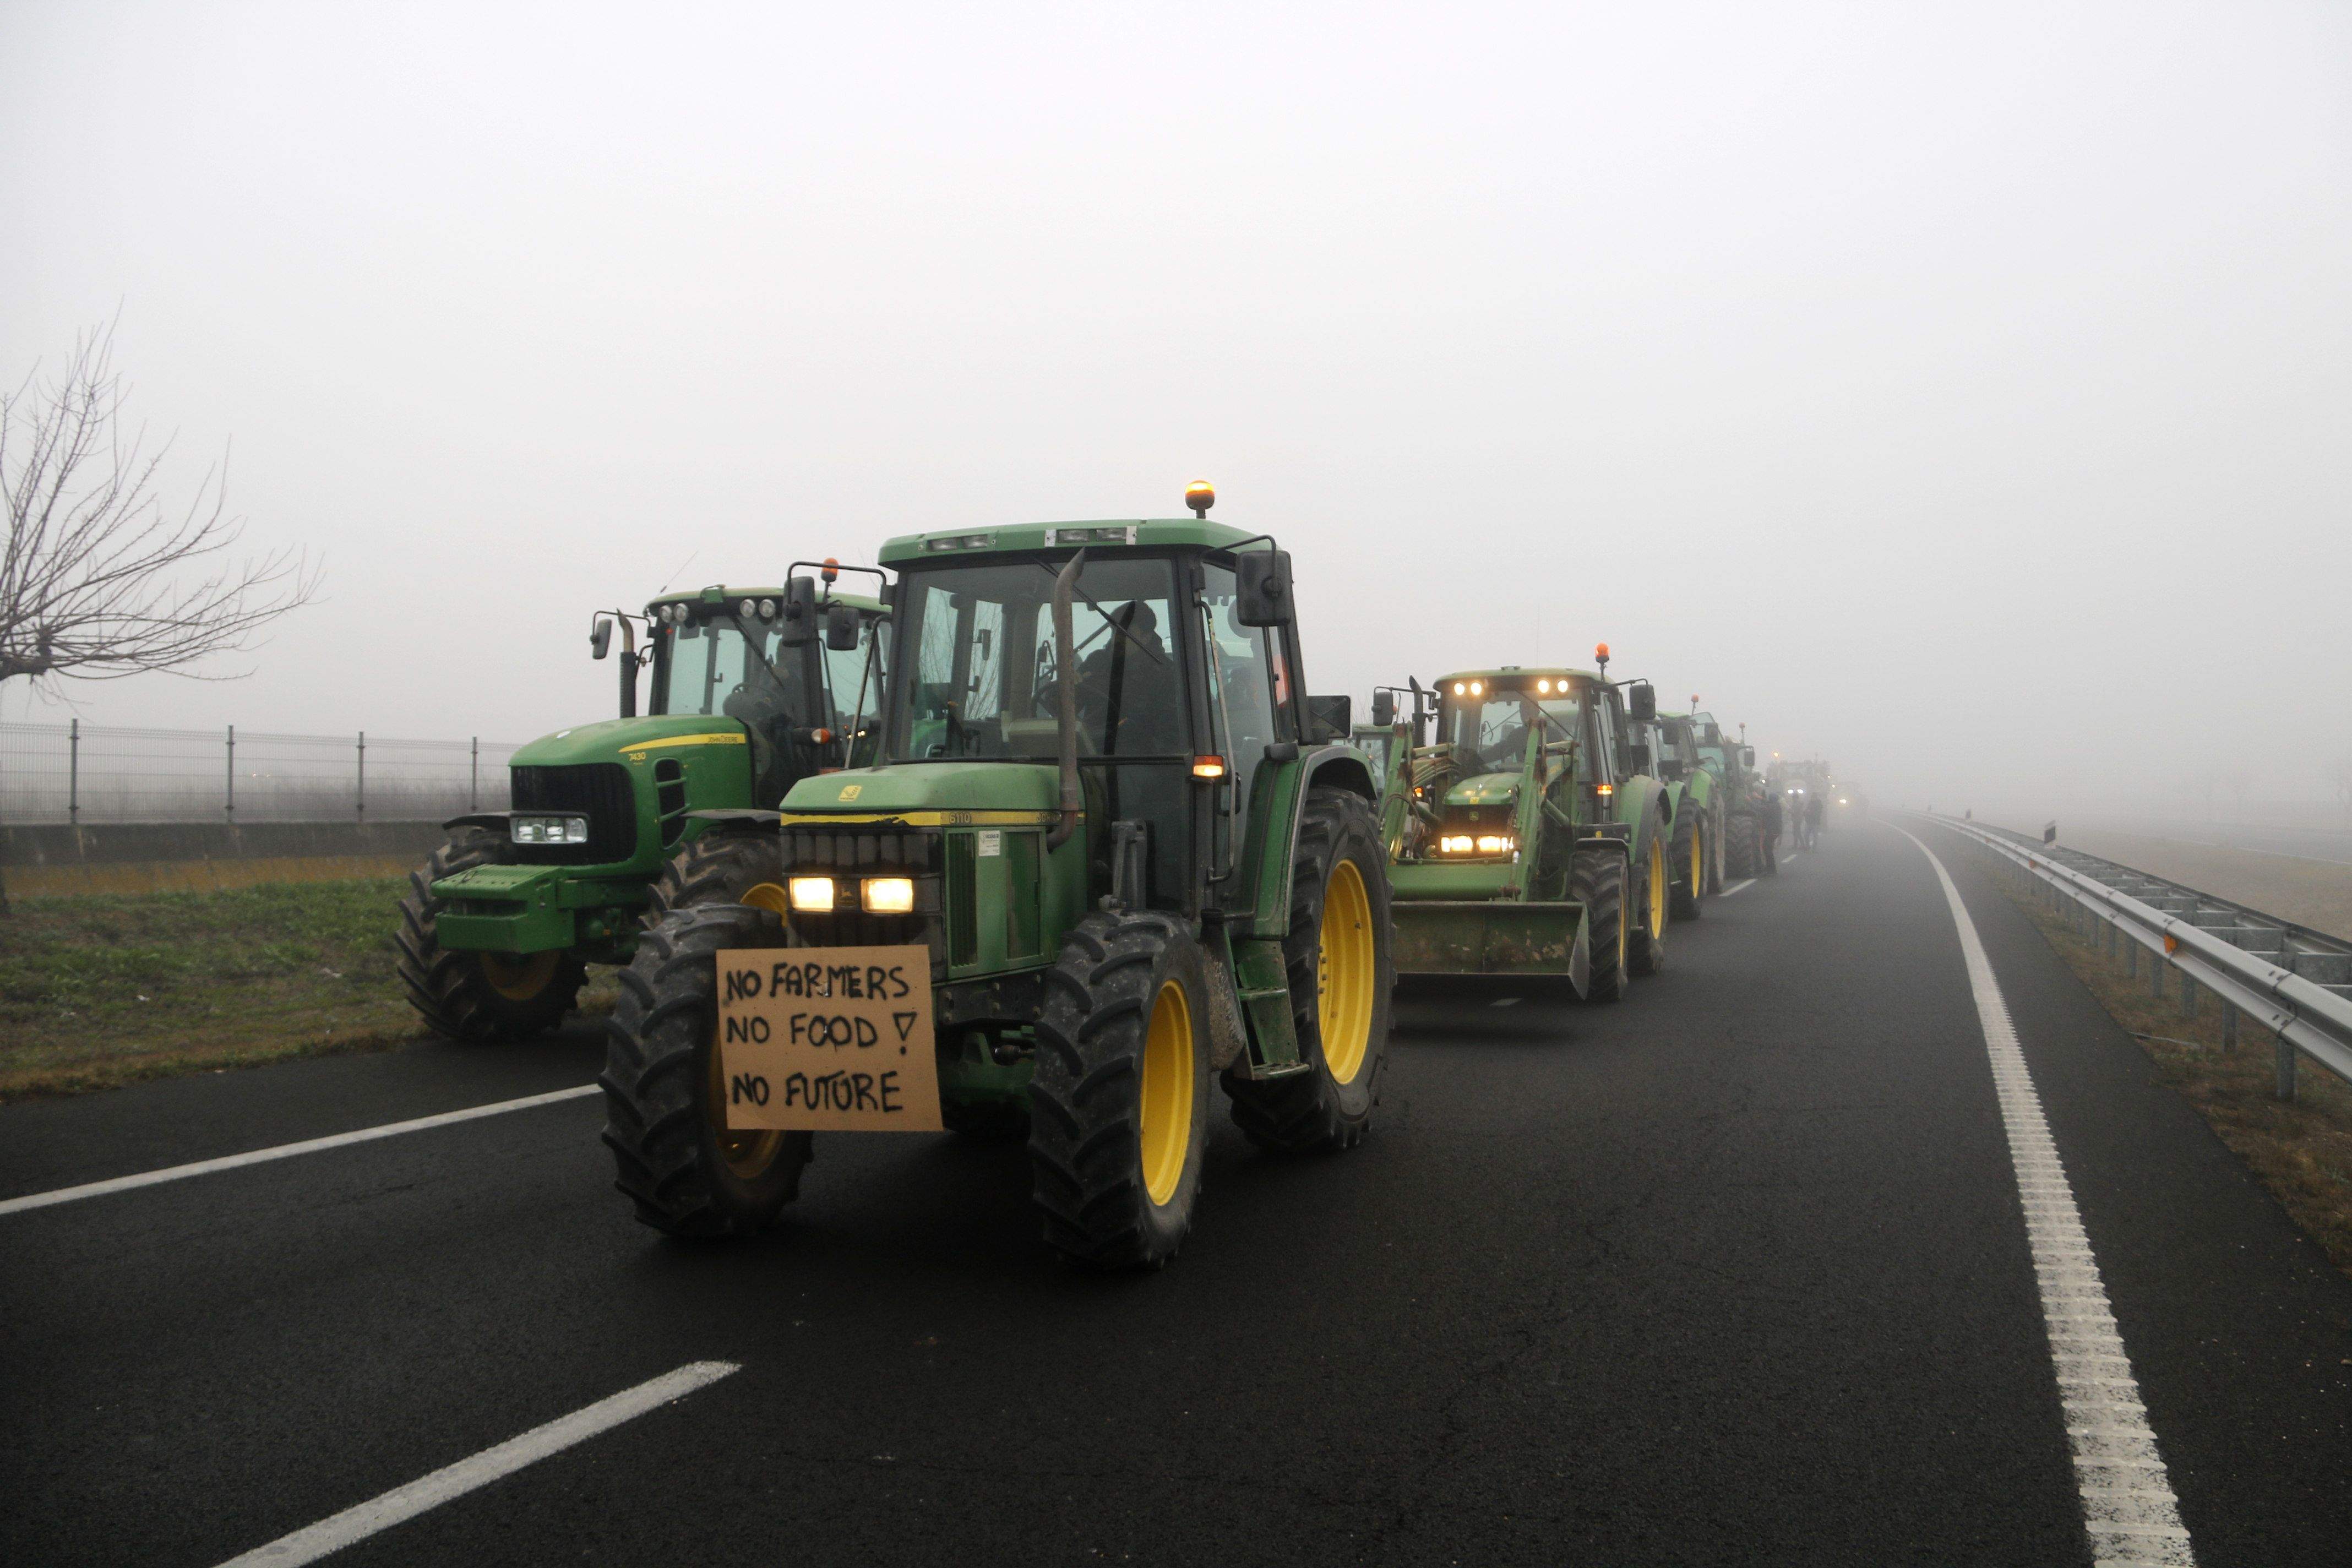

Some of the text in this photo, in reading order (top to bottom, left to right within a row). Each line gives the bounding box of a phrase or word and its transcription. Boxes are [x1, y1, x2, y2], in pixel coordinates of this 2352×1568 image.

[949, 812, 972, 824] 6110
[726, 962, 910, 1001] NO FARMERS
[726, 1016, 770, 1044] NO
[790, 1013, 878, 1047] FOOD
[732, 1070, 904, 1113] NO FUTURE
